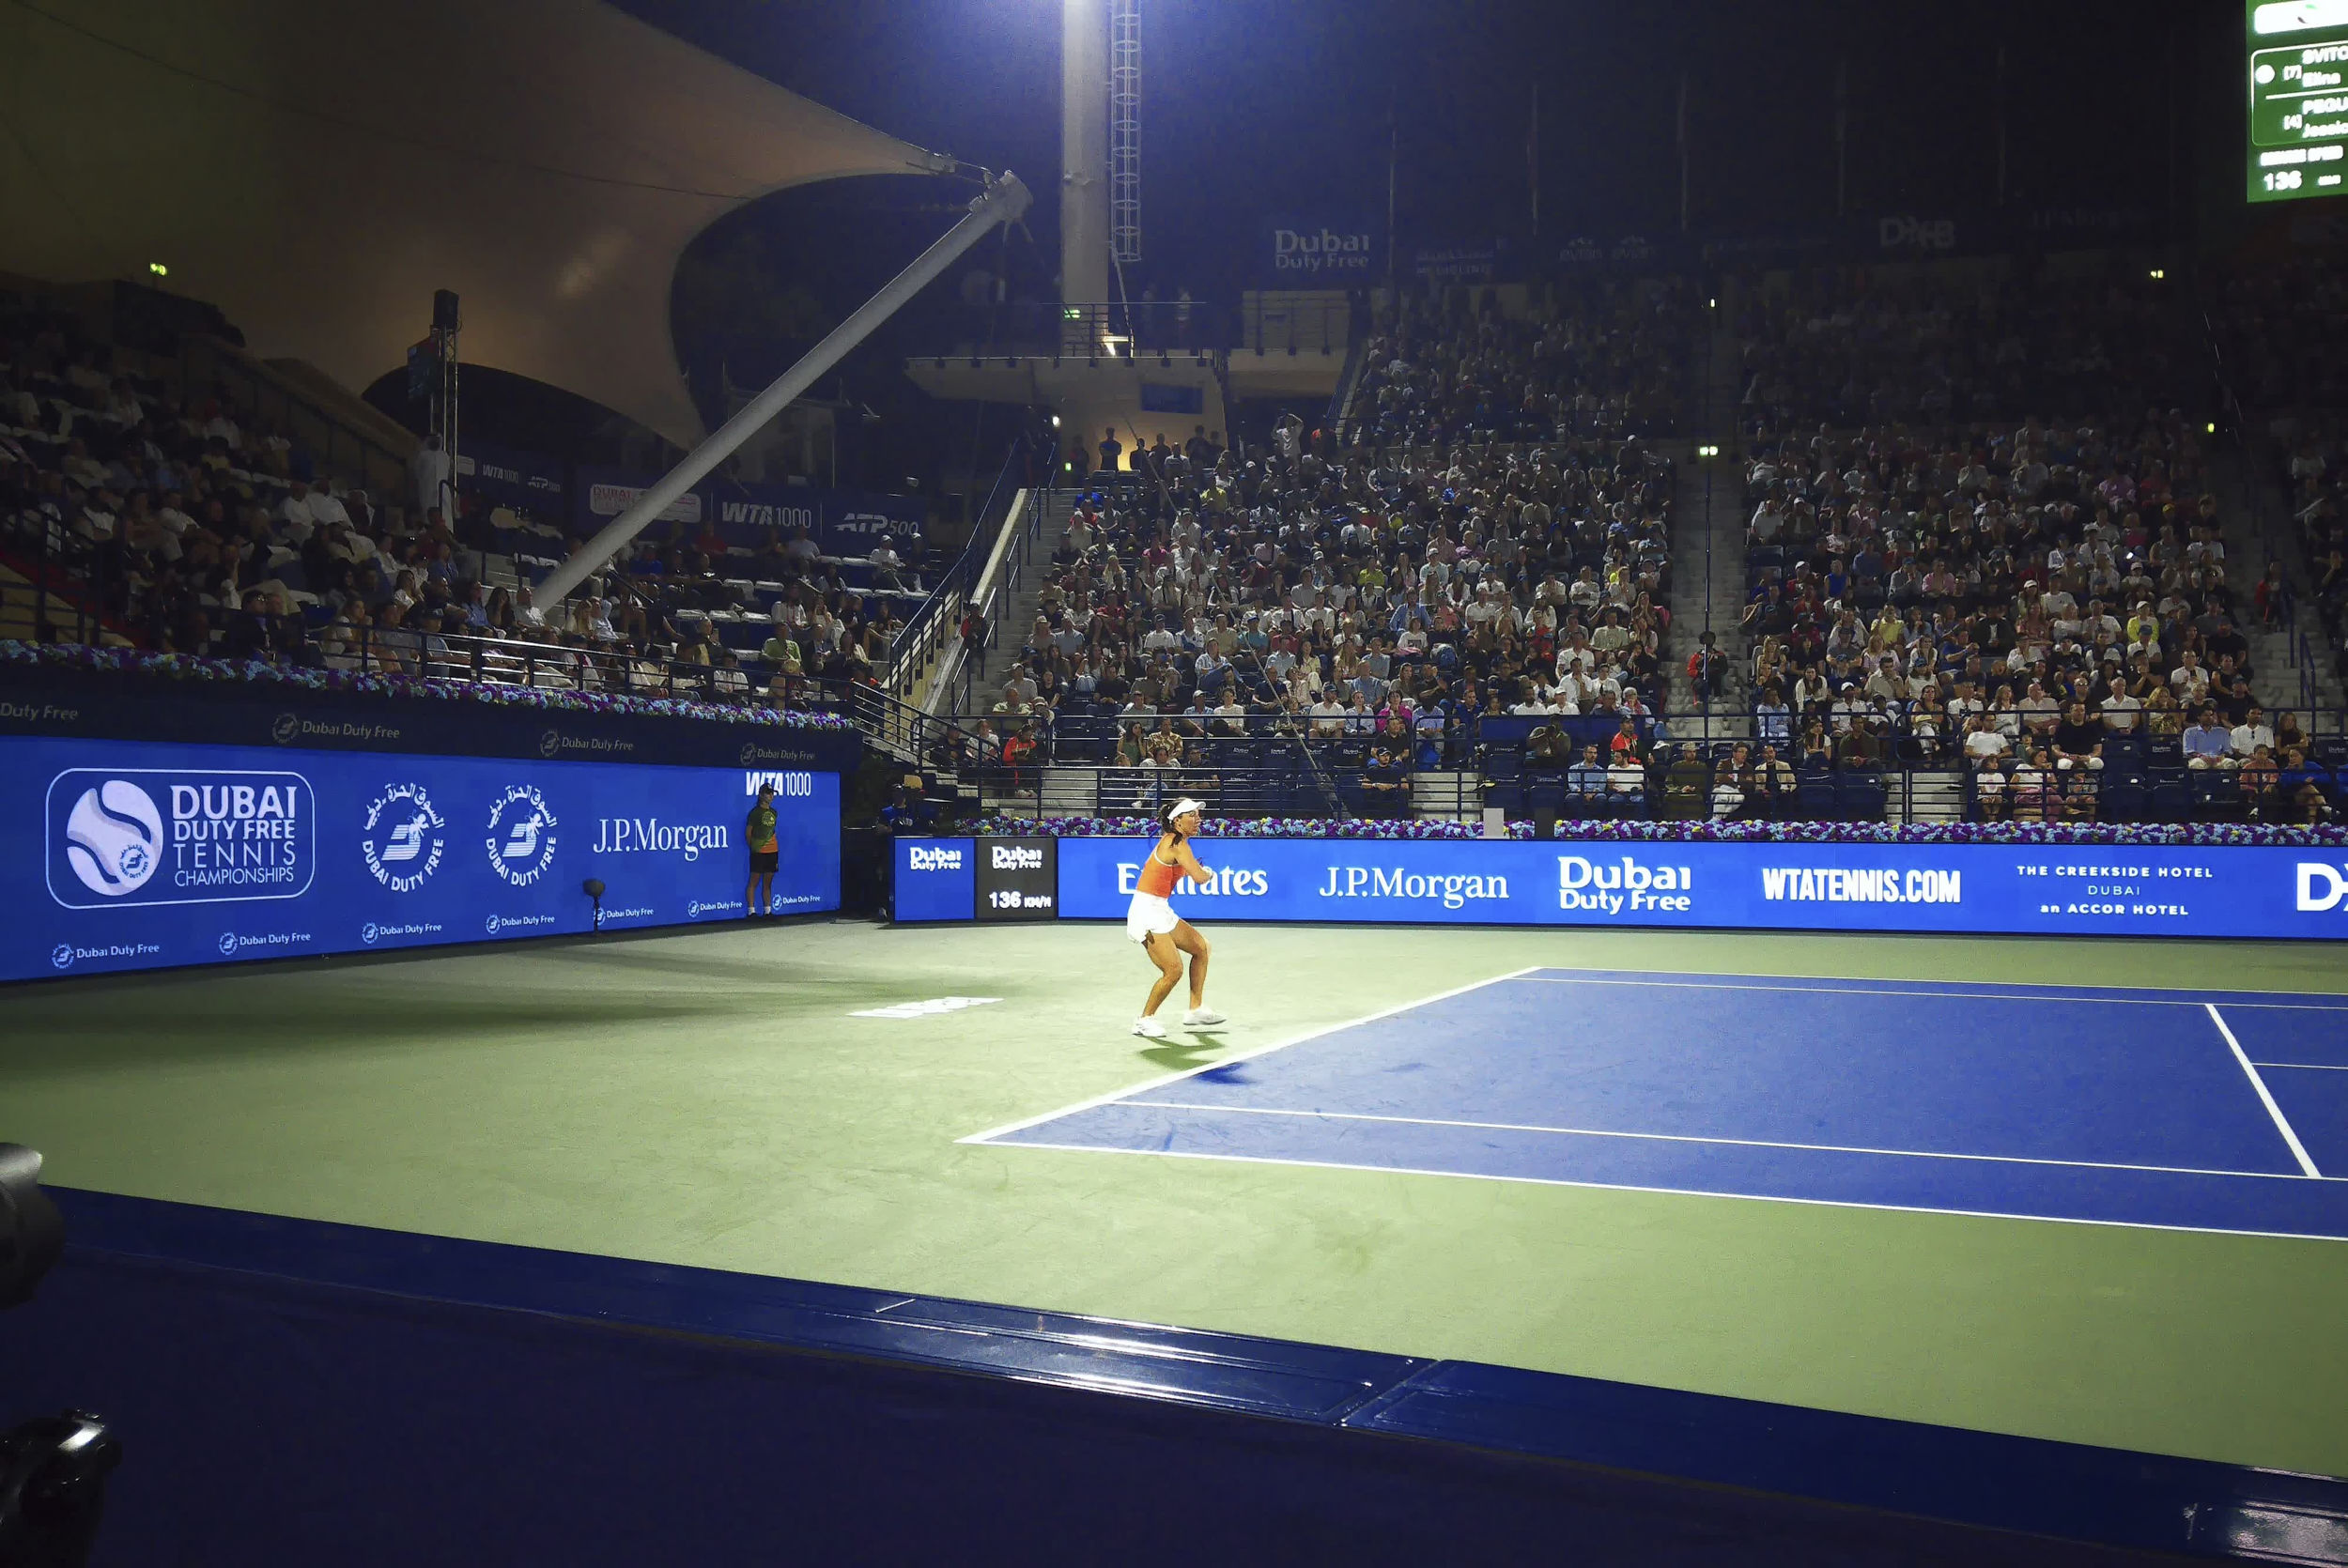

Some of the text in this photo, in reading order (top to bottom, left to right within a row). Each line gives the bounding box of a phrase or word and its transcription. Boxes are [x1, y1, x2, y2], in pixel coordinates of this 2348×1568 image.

[2263, 170, 2302, 191] 136
[1275, 229, 1370, 254] Dubai
[1275, 254, 1369, 272] Duty Free
[0, 704, 78, 721] Duty Free
[302, 720, 340, 735] Dubai
[343, 723, 372, 741] Duty
[374, 726, 400, 739] Free
[562, 736, 589, 749] Dubai
[591, 737, 612, 751] Duty
[613, 740, 633, 750] Free
[757, 748, 779, 760] Dubai
[170, 785, 297, 820] DUBAI
[173, 819, 295, 841] DUTY FREE
[594, 819, 728, 861] J.P.Morgan
[173, 840, 296, 869] TENNIS
[486, 837, 556, 886] DUBAI DUTY FREE
[910, 847, 962, 861] Dubai
[992, 846, 1043, 861] Dubai
[362, 838, 443, 892] DUBAI DUTY FREE
[910, 859, 962, 871] Duty Free
[992, 859, 1043, 870] Duty Free
[1557, 856, 1691, 890] Dubai
[2016, 866, 2213, 878] THE CREEKSIDE HOTEL
[175, 867, 294, 886] CHAMPIONSHIPS
[1762, 868, 1962, 903] WTATENNIS.COM
[1320, 867, 1509, 909] J.P.Morgan
[2088, 885, 2140, 896] DUBAI
[2297, 863, 2348, 911] D
[989, 891, 1022, 909] 136
[1559, 888, 1691, 916] Duty Free
[2040, 903, 2189, 915] an ACCOR HOTEL
[379, 926, 403, 936] Dubai
[405, 924, 423, 935] Duty
[425, 923, 441, 932] Free
[502, 916, 521, 927] Dubai
[523, 915, 539, 927] Duty
[541, 915, 554, 924] Free
[239, 935, 267, 945] Dubai
[269, 933, 289, 945] Duty
[292, 932, 311, 942] Free
[76, 947, 107, 959] Dubai
[111, 945, 134, 956] Duty
[138, 944, 160, 953] Free
